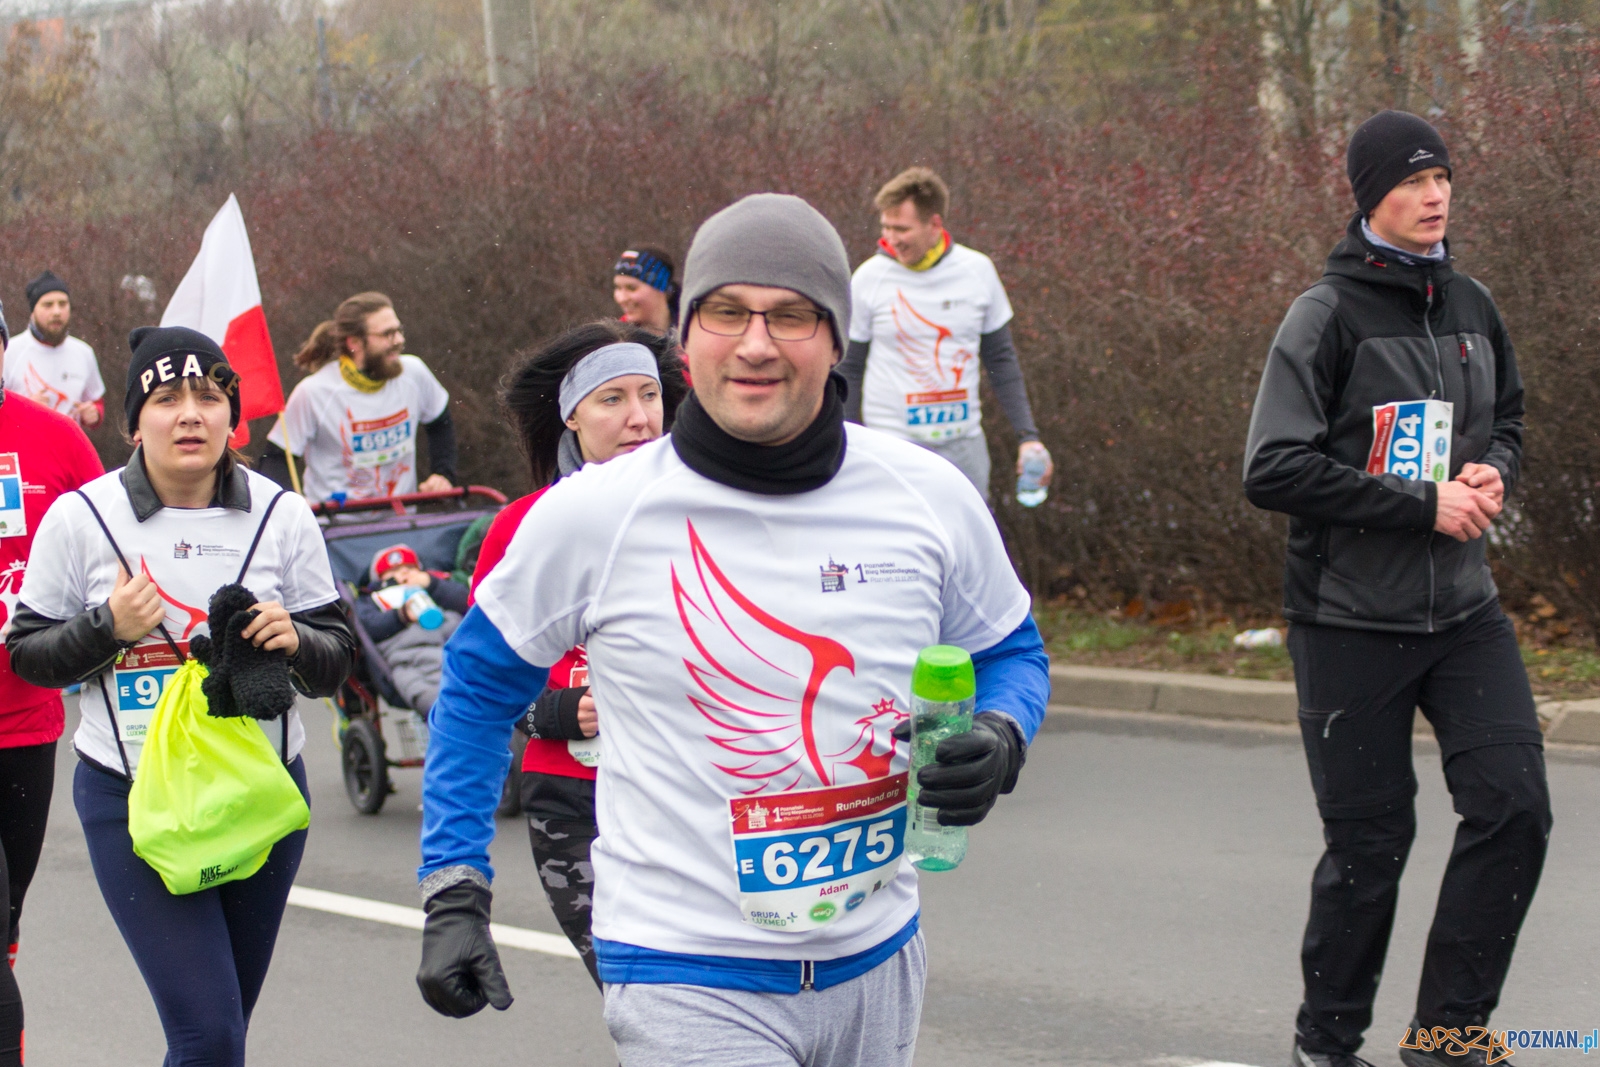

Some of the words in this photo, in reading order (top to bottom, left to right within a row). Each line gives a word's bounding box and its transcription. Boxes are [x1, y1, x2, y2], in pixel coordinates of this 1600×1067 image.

[140, 354, 242, 397] PEACE
[120, 686, 130, 697] E
[134, 674, 174, 706] 9
[836, 787, 900, 812] RunPoland.org
[761, 818, 895, 886] 6275
[200, 864, 221, 880] NIKE
[740, 858, 755, 875] E
[819, 883, 850, 897] Adam
[750, 910, 781, 919] GRUPA
[751, 917, 787, 927] LUXMED
